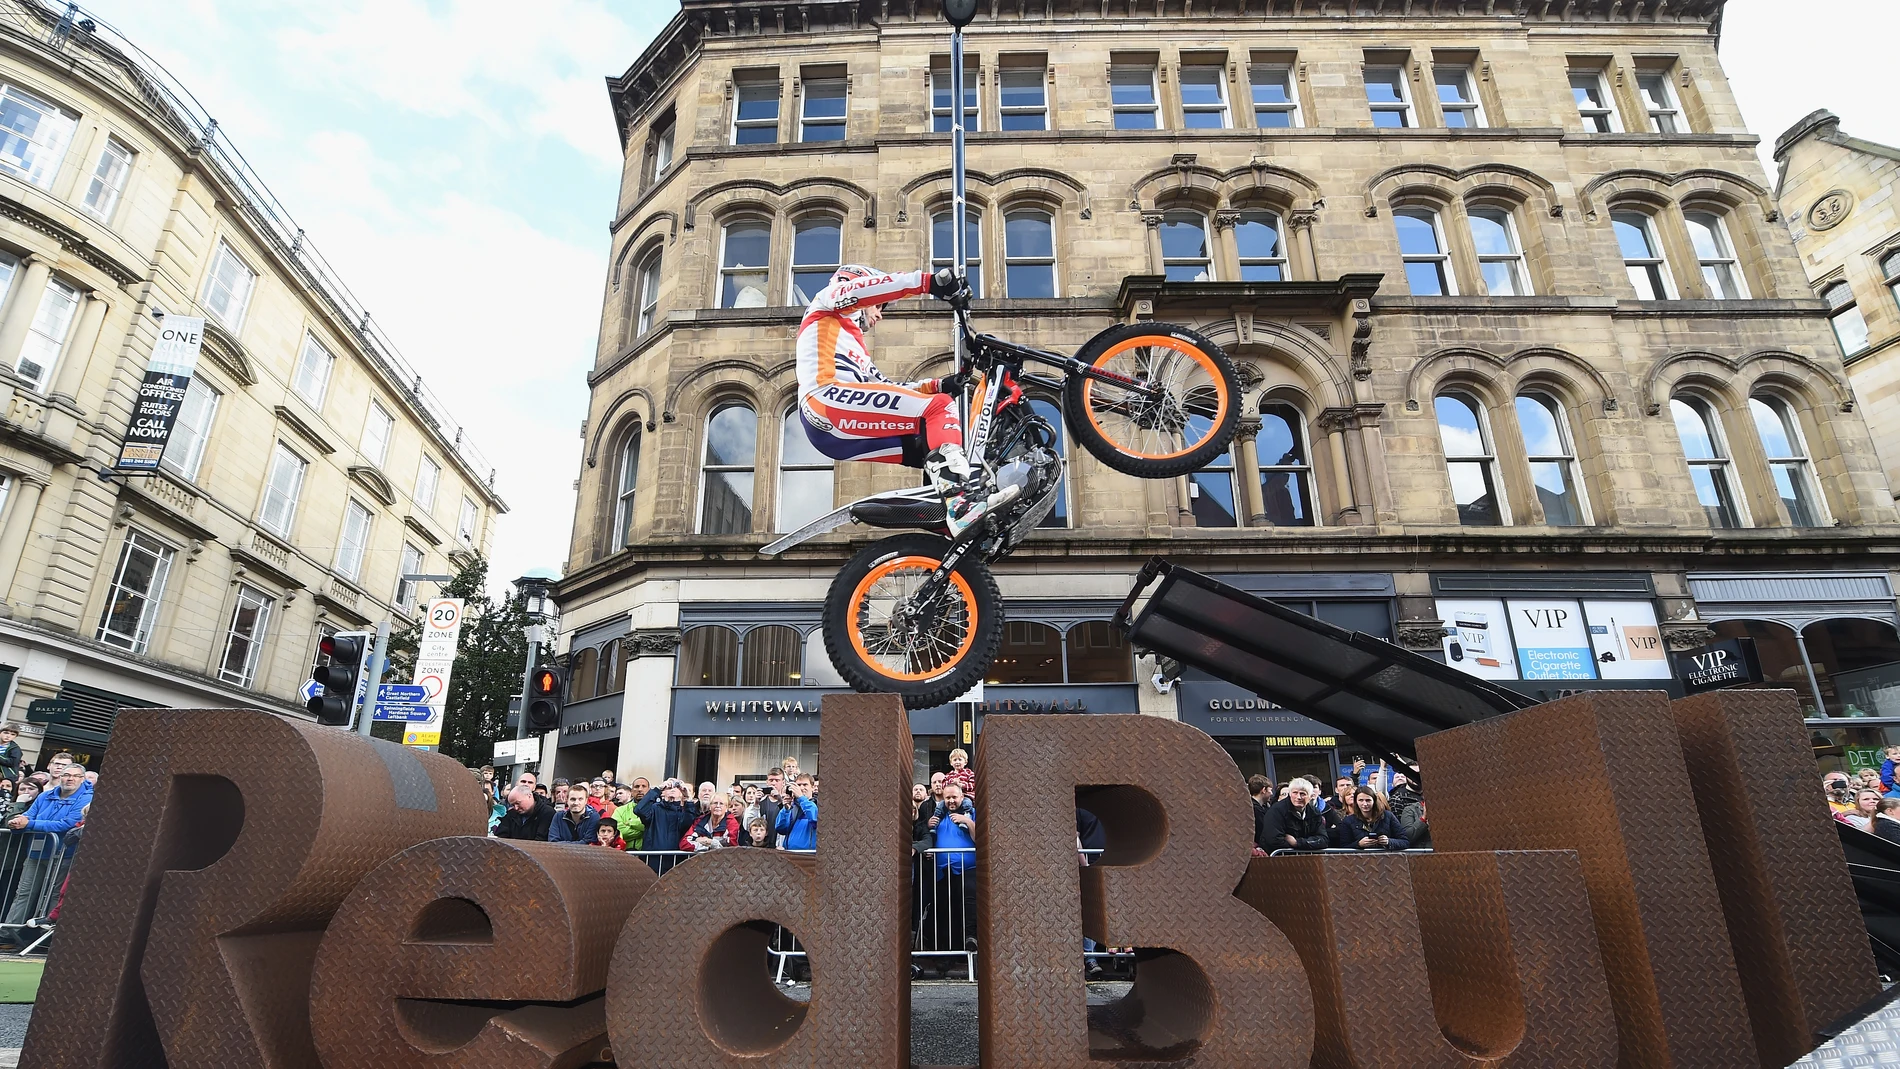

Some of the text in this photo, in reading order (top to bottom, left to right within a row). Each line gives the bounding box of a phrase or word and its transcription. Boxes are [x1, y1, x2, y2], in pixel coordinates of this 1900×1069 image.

[162, 329, 198, 345] ONE
[157, 377, 174, 387] AIR
[142, 383, 186, 394] CONDITIONED
[140, 388, 184, 402] OFFICES
[823, 386, 902, 410] REPSOL
[140, 407, 172, 417] FLOORS
[136, 418, 166, 430] CALL
[838, 418, 915, 430] Montesa
[976, 402, 993, 447] REPSOL
[129, 427, 169, 439] NOW!
[434, 609, 455, 621] 20
[1522, 608, 1568, 629] VIP
[1461, 631, 1485, 644] VIP
[1629, 637, 1657, 649] VIP
[1527, 650, 1579, 660] Electronic
[1691, 649, 1727, 671] VIP
[1531, 660, 1581, 672] Cigarette
[1688, 663, 1739, 680] ELECTRONIC
[1526, 670, 1590, 680] Outlet Store
[1692, 671, 1738, 686] CIGARETTE
[705, 700, 818, 713] WHITEWAL
[979, 699, 1088, 711] HITEWALL
[1209, 698, 1283, 710] GOLDMA
[562, 717, 617, 736] WHITEWALL
[1265, 737, 1336, 747] 3RD PARTY CHEQUES CASHED
[22, 688, 1876, 1069] Red Bull
